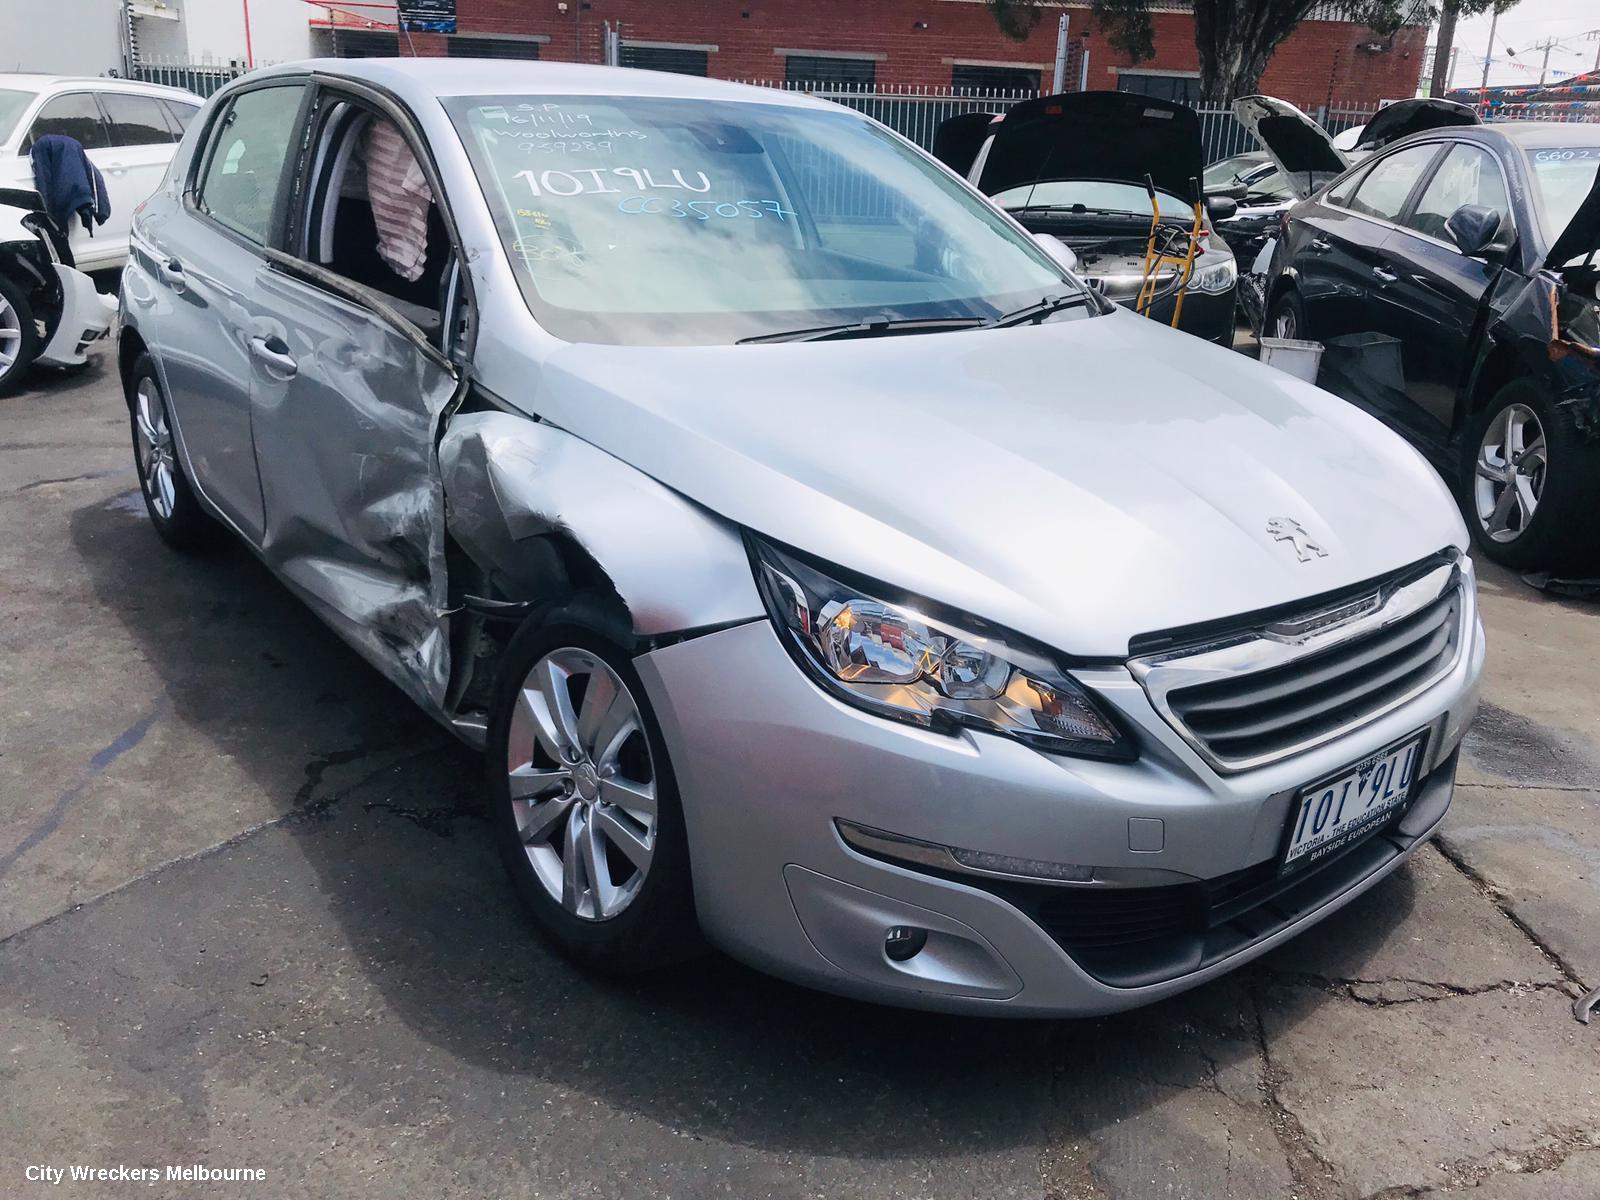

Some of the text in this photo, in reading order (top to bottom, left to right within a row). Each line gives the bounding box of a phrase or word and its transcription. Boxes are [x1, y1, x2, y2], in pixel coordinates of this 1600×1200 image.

[617, 195, 799, 223] CC35057
[1289, 834, 1325, 858] VICTORIA
[1331, 823, 1345, 838] THE
[1347, 804, 1387, 829] EDUCATION
[1310, 811, 1392, 861] BAYSIDE EUROPEAN
